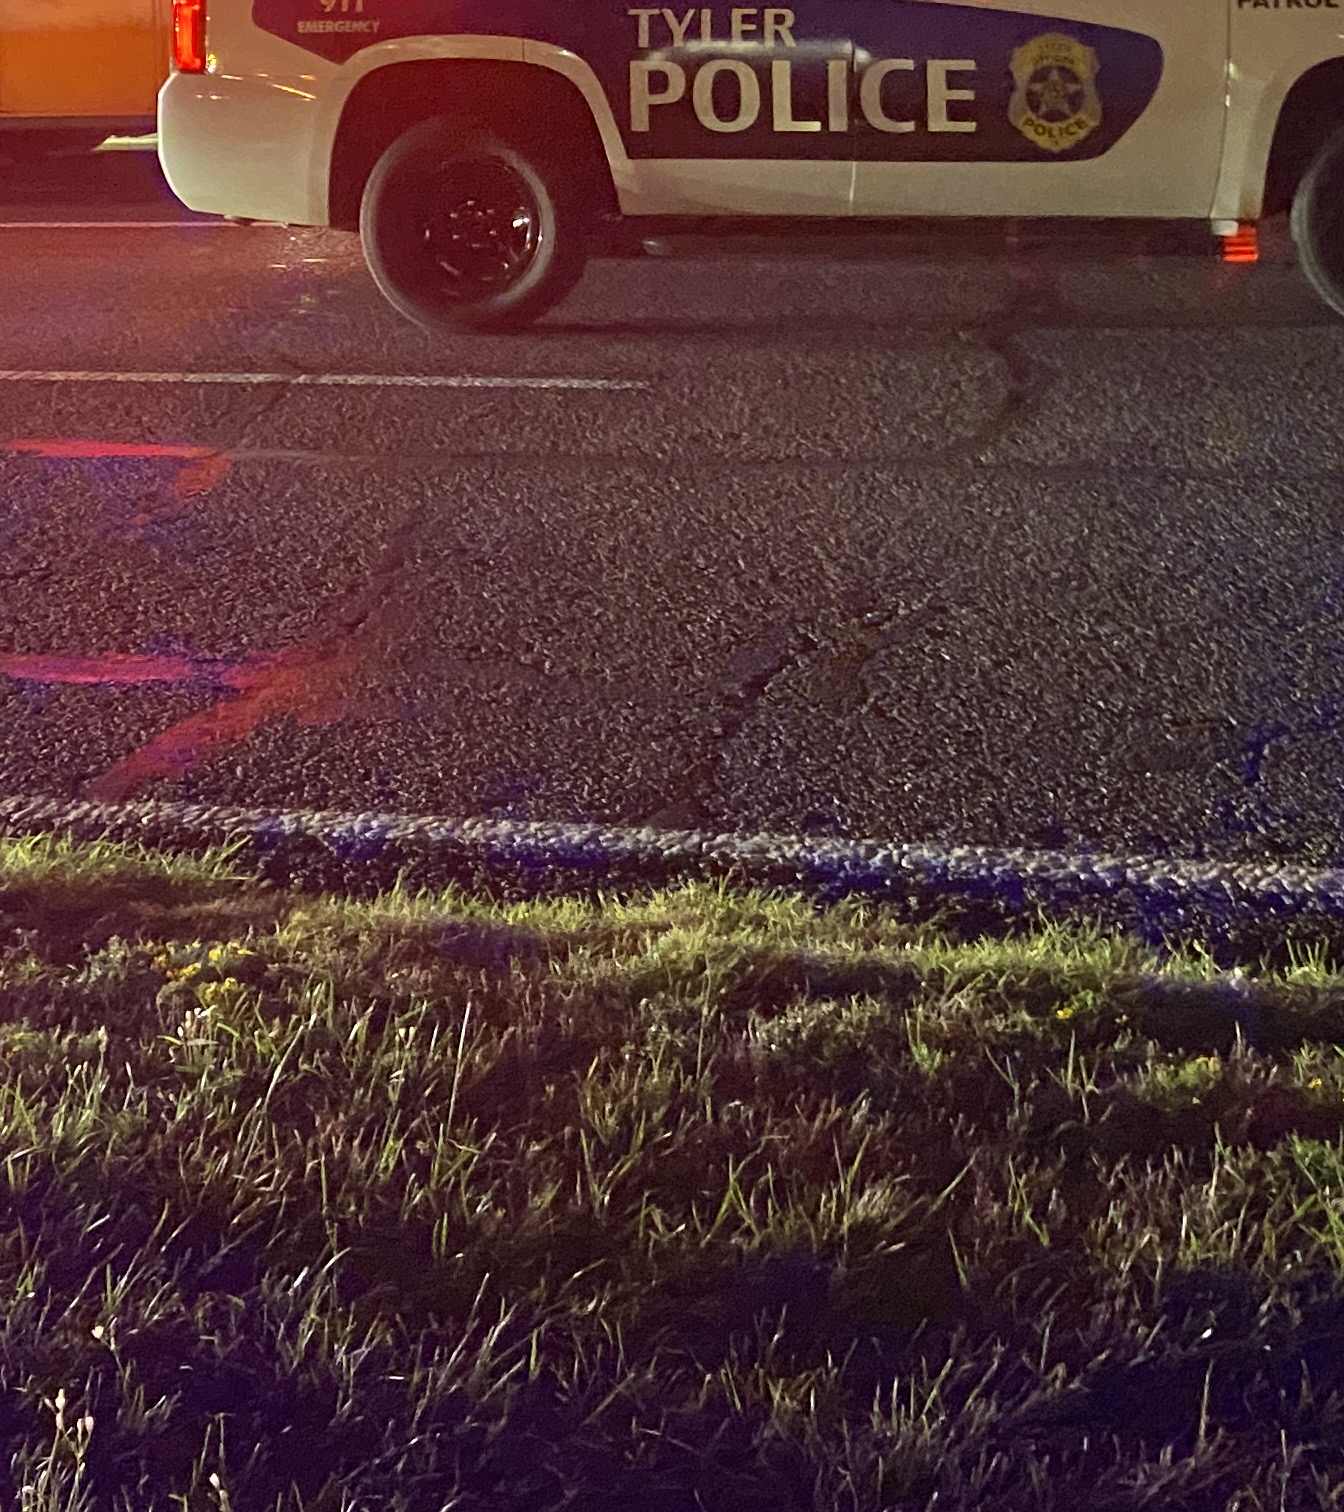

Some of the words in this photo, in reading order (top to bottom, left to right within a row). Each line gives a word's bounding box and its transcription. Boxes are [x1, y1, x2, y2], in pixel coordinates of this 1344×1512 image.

[297, 20, 380, 33] EMERGENCY
[628, 8, 797, 48] TYLER
[629, 58, 977, 133] POLICE
[1022, 117, 1088, 139] POLICE
